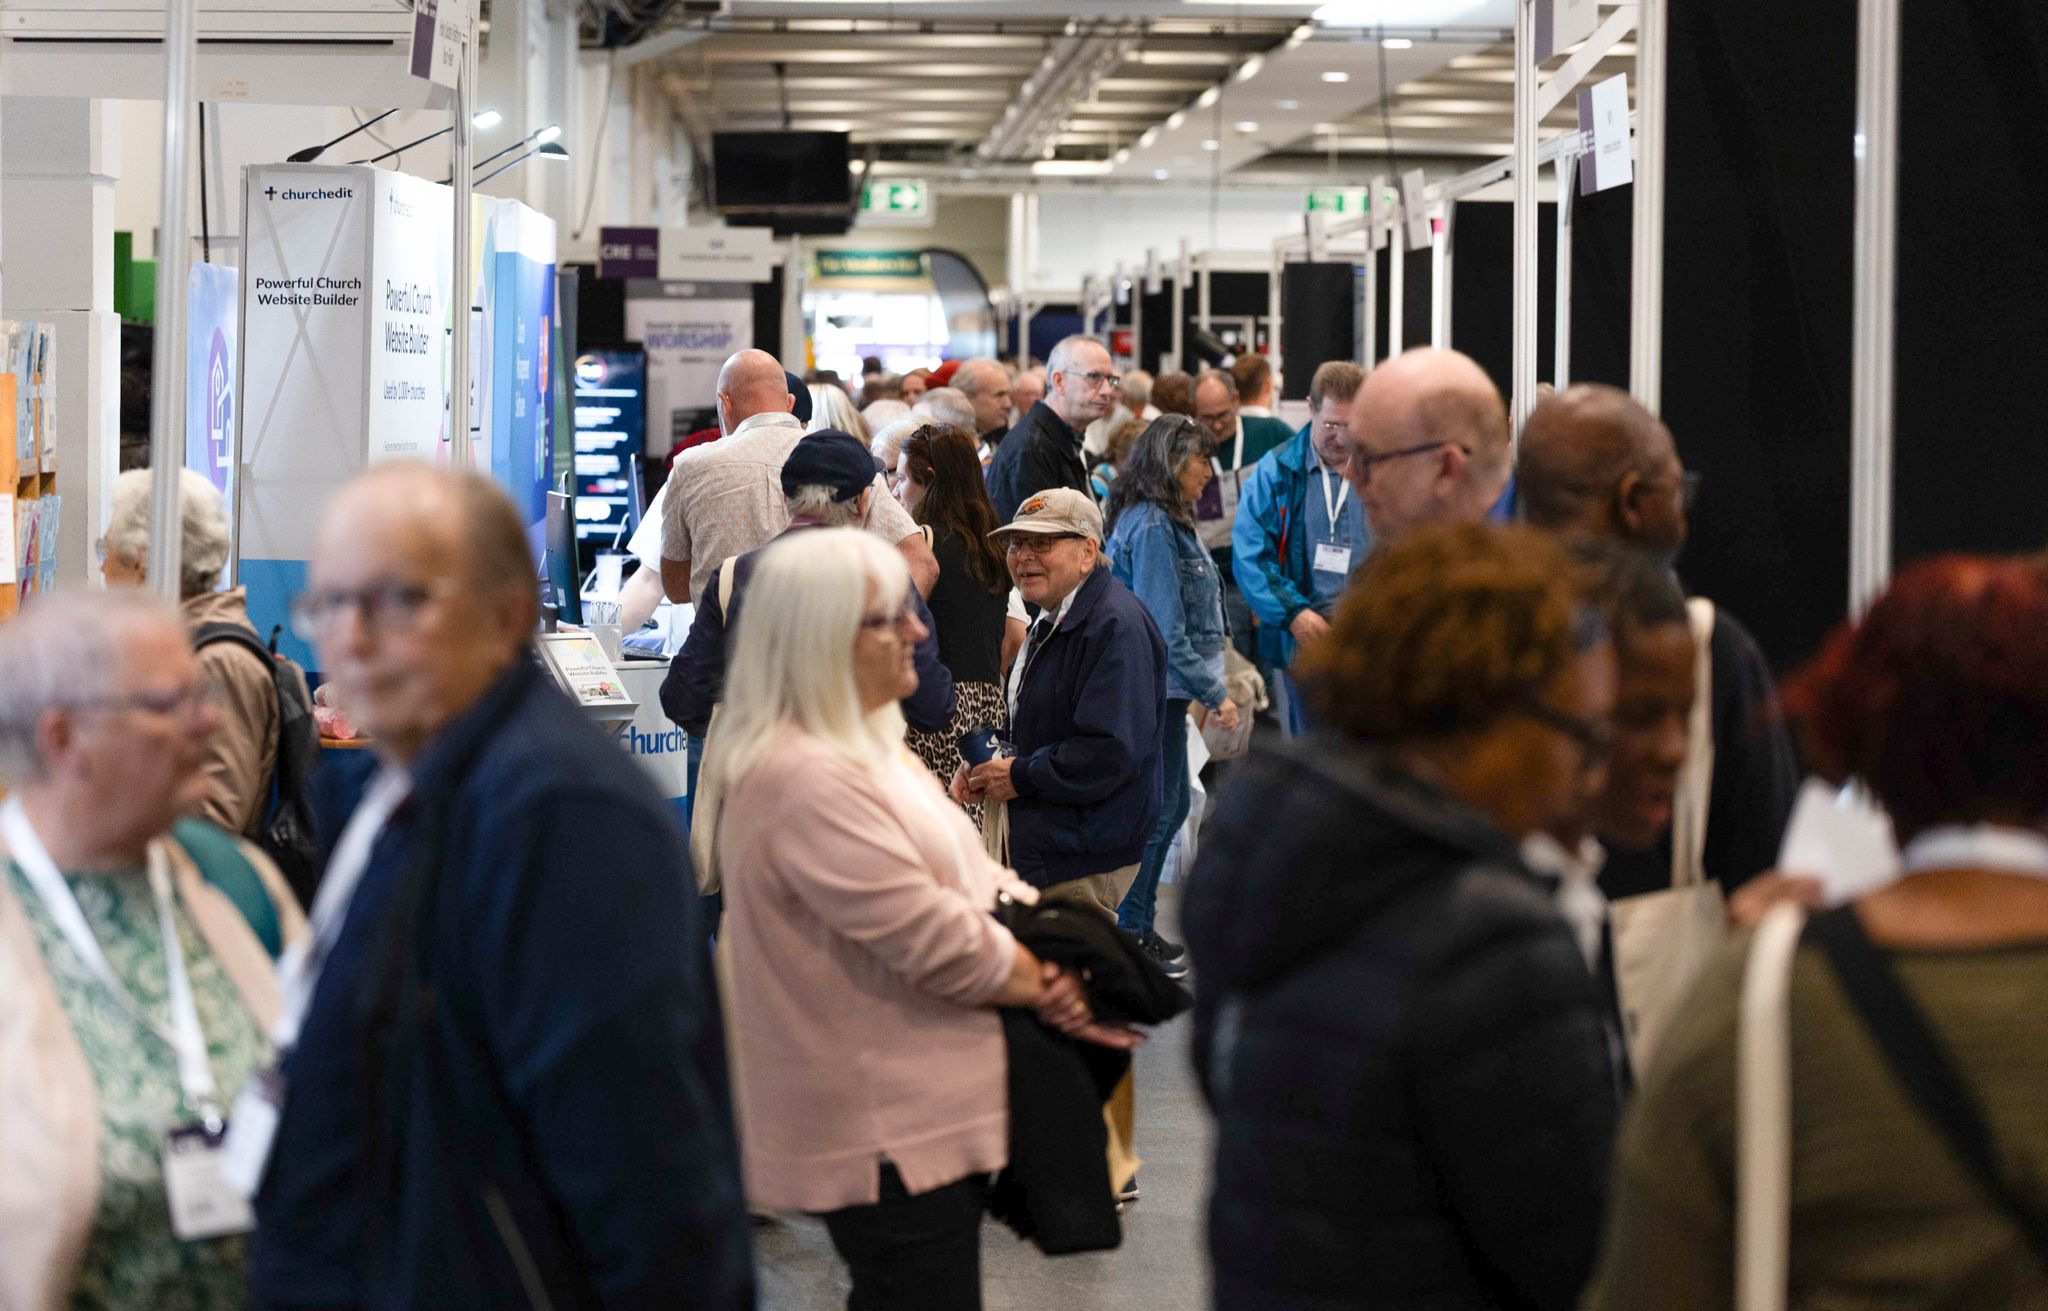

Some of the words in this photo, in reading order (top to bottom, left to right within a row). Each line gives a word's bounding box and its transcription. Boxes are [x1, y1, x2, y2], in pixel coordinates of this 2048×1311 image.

[281, 187, 353, 200] churchedit
[256, 277, 314, 289] Powerful
[316, 277, 362, 289] Church
[257, 293, 311, 305] Website
[313, 293, 359, 305] Builder
[386, 278, 411, 313] Powerful
[412, 283, 432, 315] Church
[384, 321, 408, 353] Website
[409, 323, 429, 355] Builder
